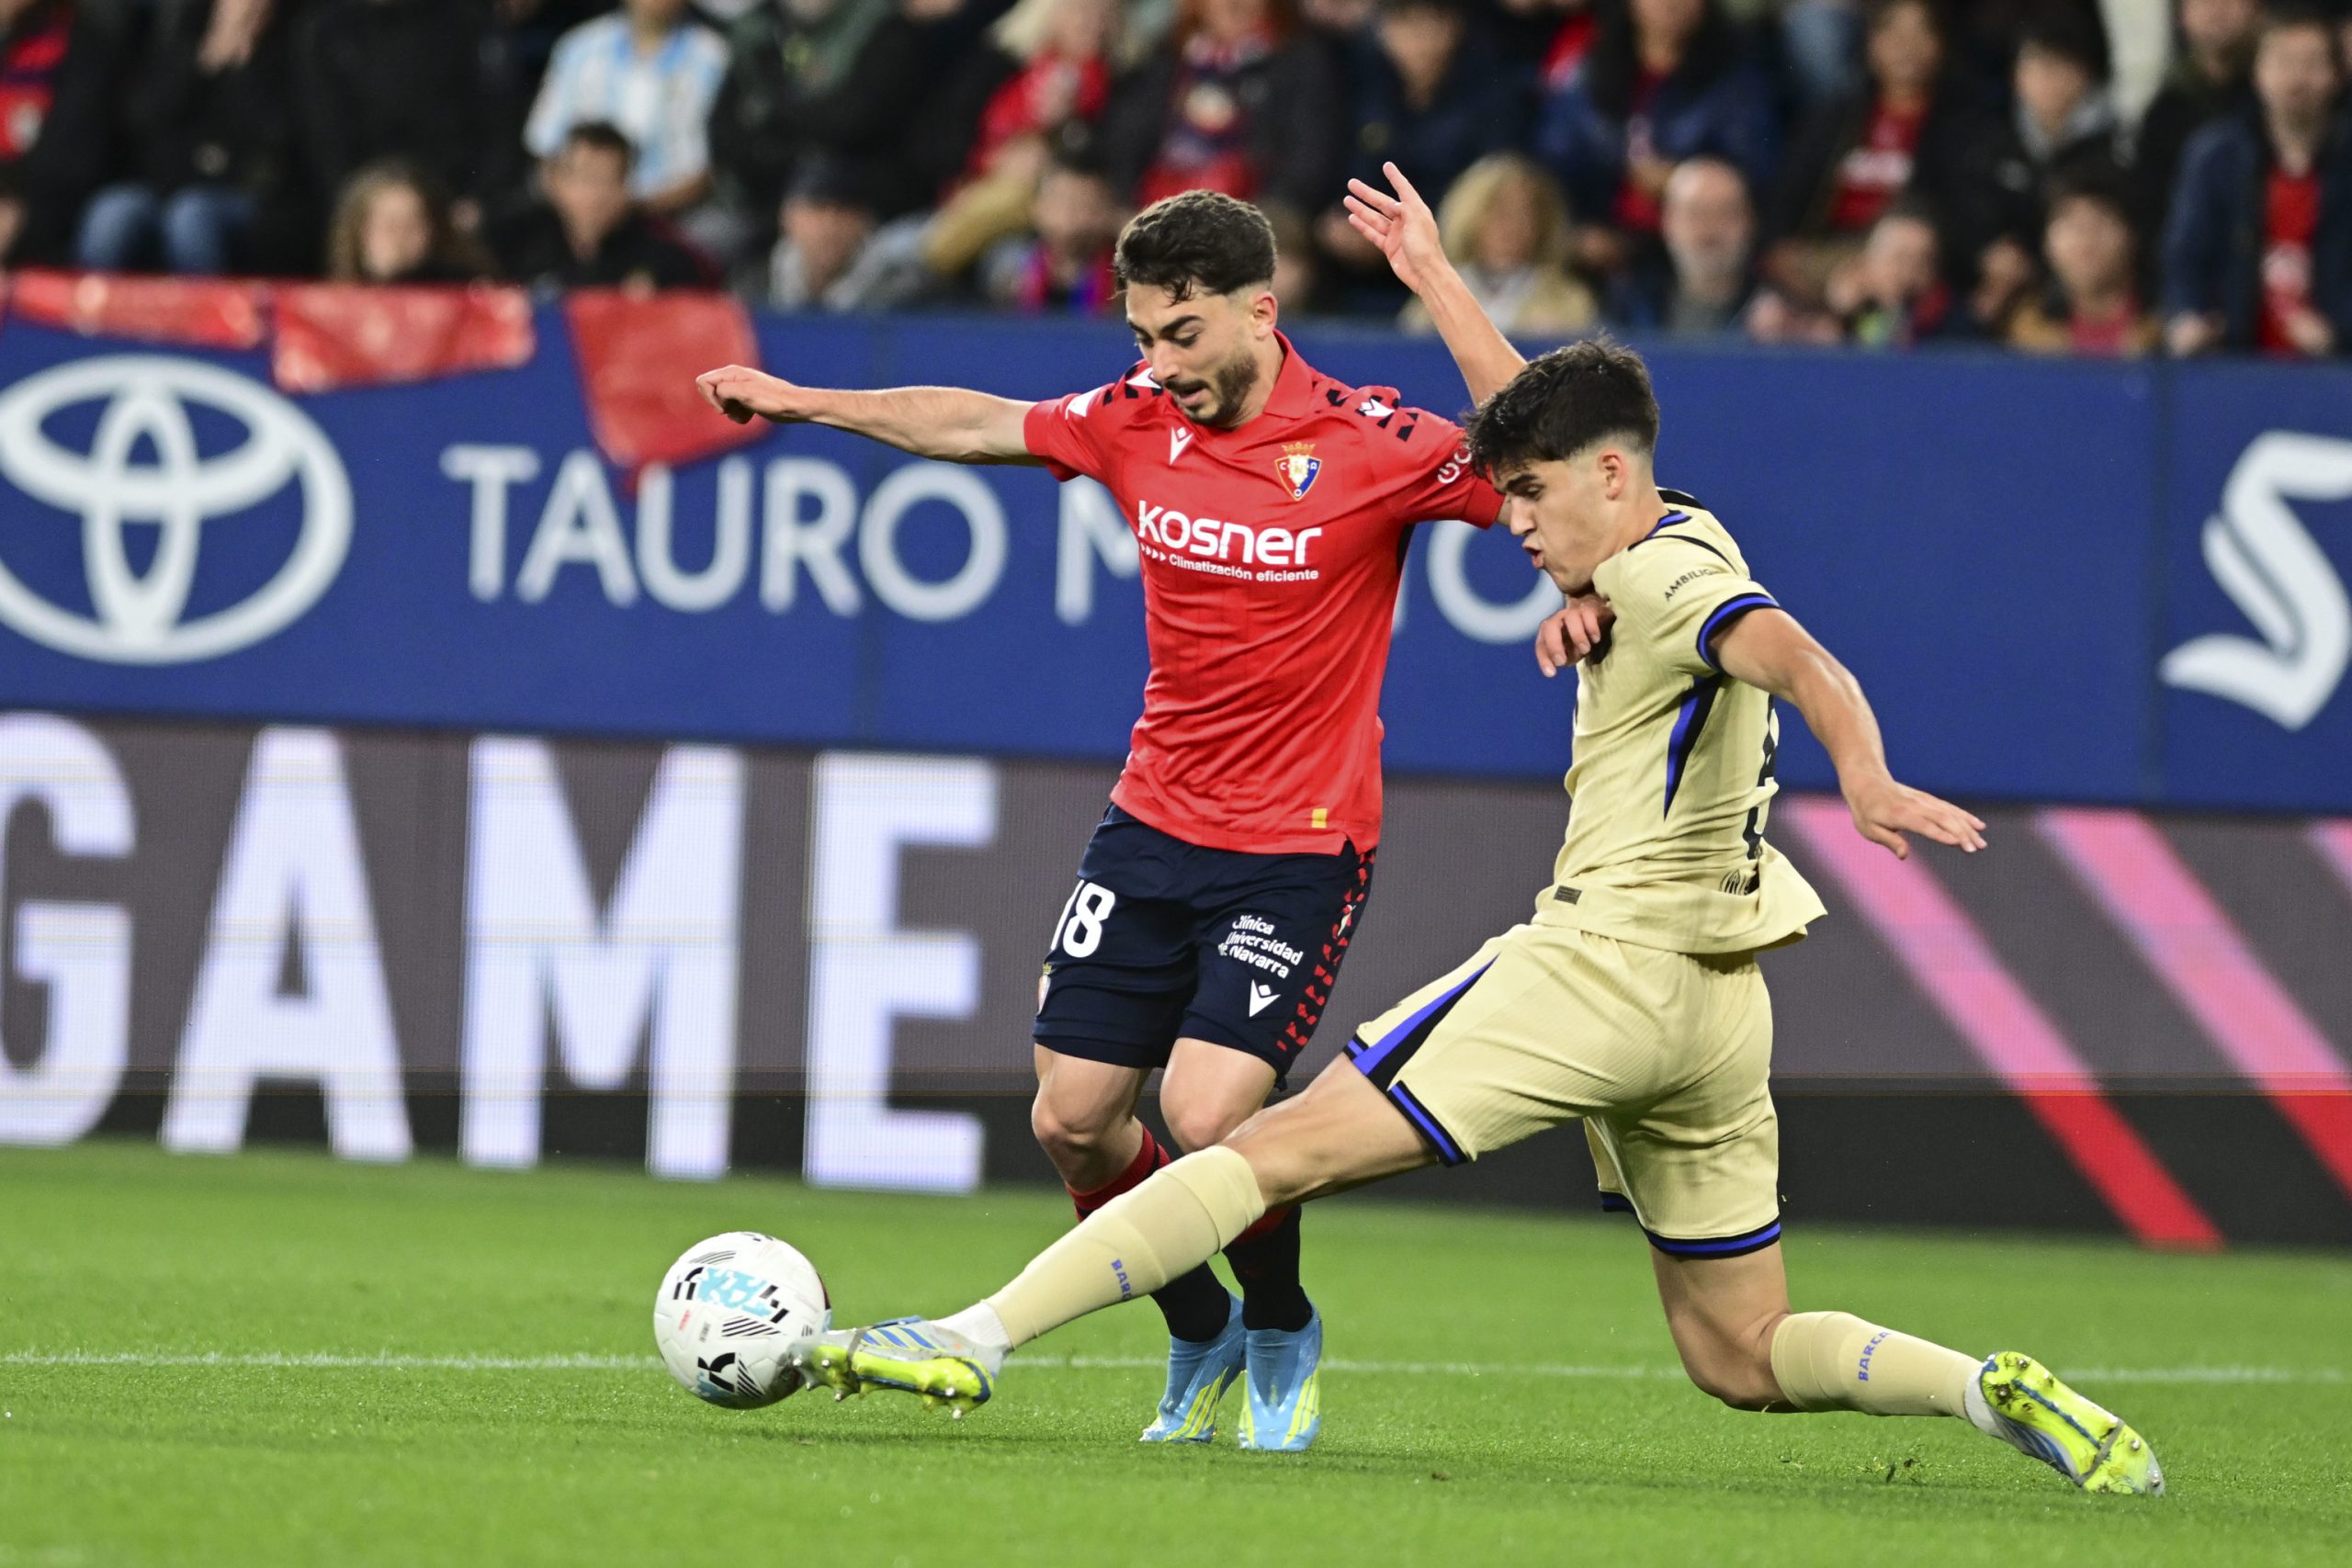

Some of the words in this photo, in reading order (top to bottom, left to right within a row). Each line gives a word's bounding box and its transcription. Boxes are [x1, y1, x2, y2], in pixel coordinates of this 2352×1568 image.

[440, 445, 1007, 623] TAURO
[1169, 553, 1252, 581] Climatización
[1256, 569, 1319, 582] eficiente
[0, 711, 998, 1194] GAME
[1229, 945, 1289, 979] Navarra
